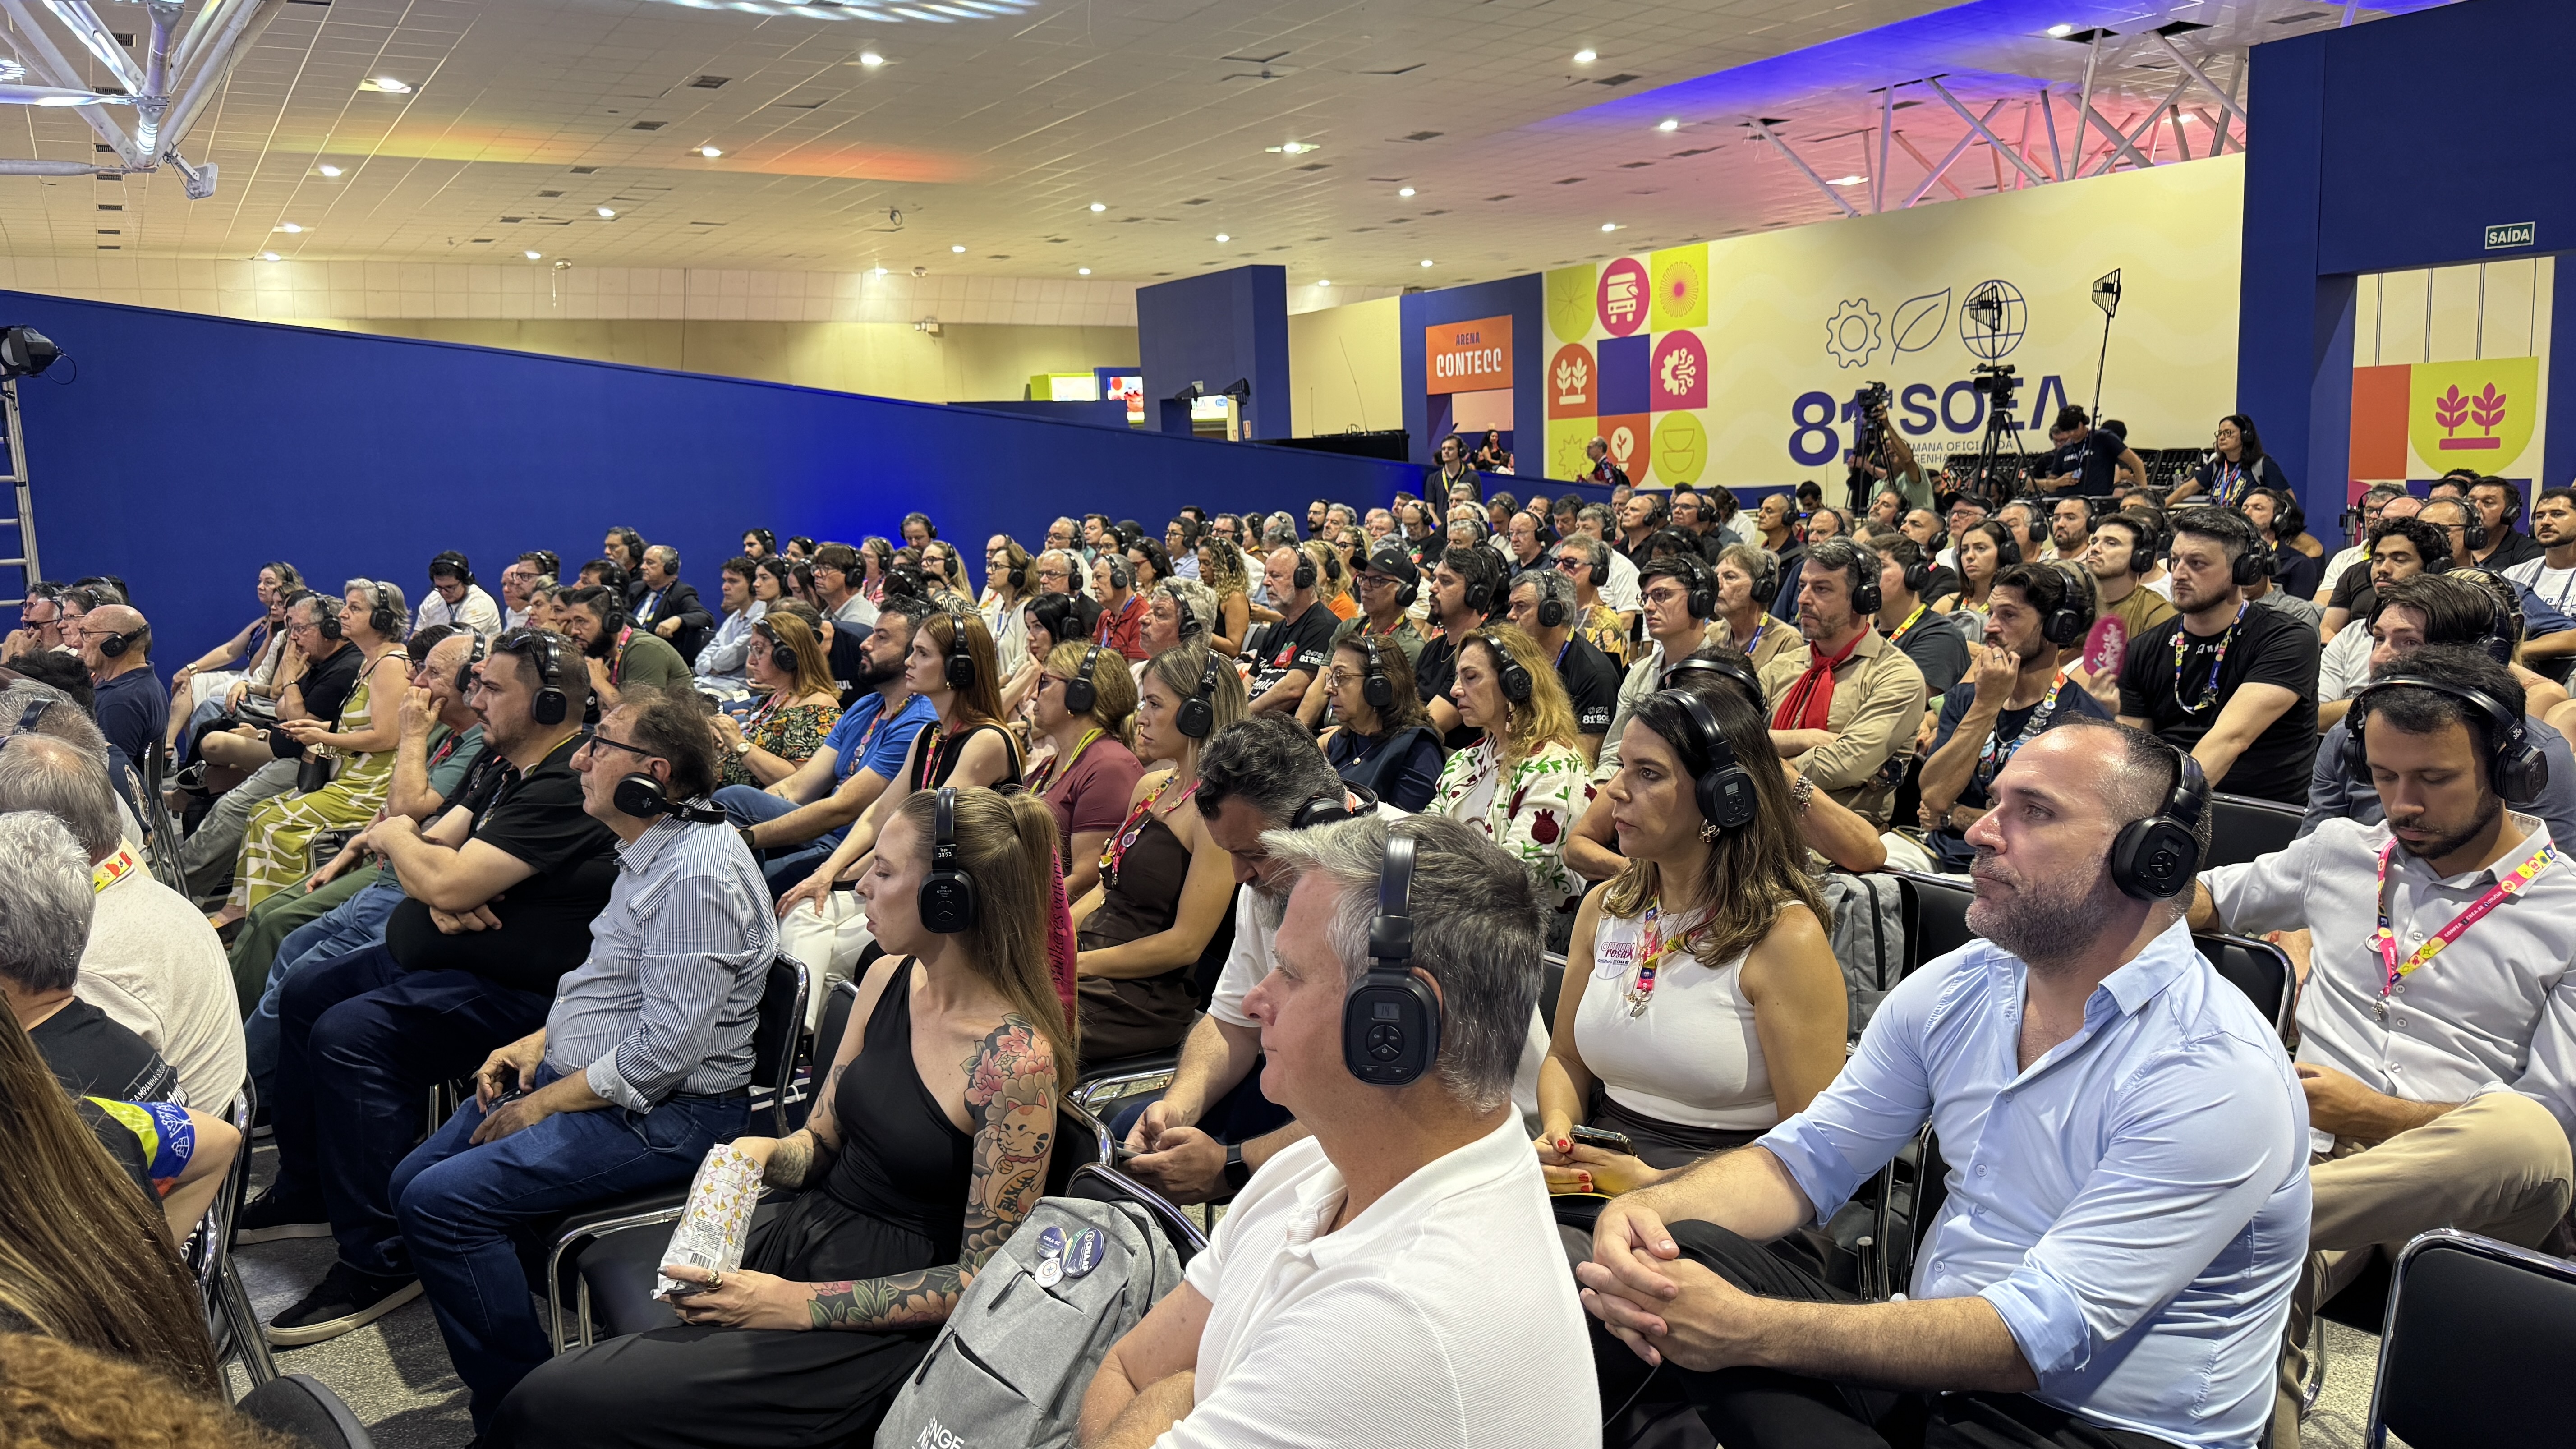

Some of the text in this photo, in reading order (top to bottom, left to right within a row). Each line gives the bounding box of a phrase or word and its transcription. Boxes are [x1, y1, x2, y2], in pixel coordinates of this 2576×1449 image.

[2489, 227, 2530, 244] SAÍDA
[1456, 332, 1480, 346] ARENA
[1436, 348, 1501, 377] CONTECC
[2444, 922, 2463, 938] CONFEA
[1381, 1005, 1390, 1016] 14
